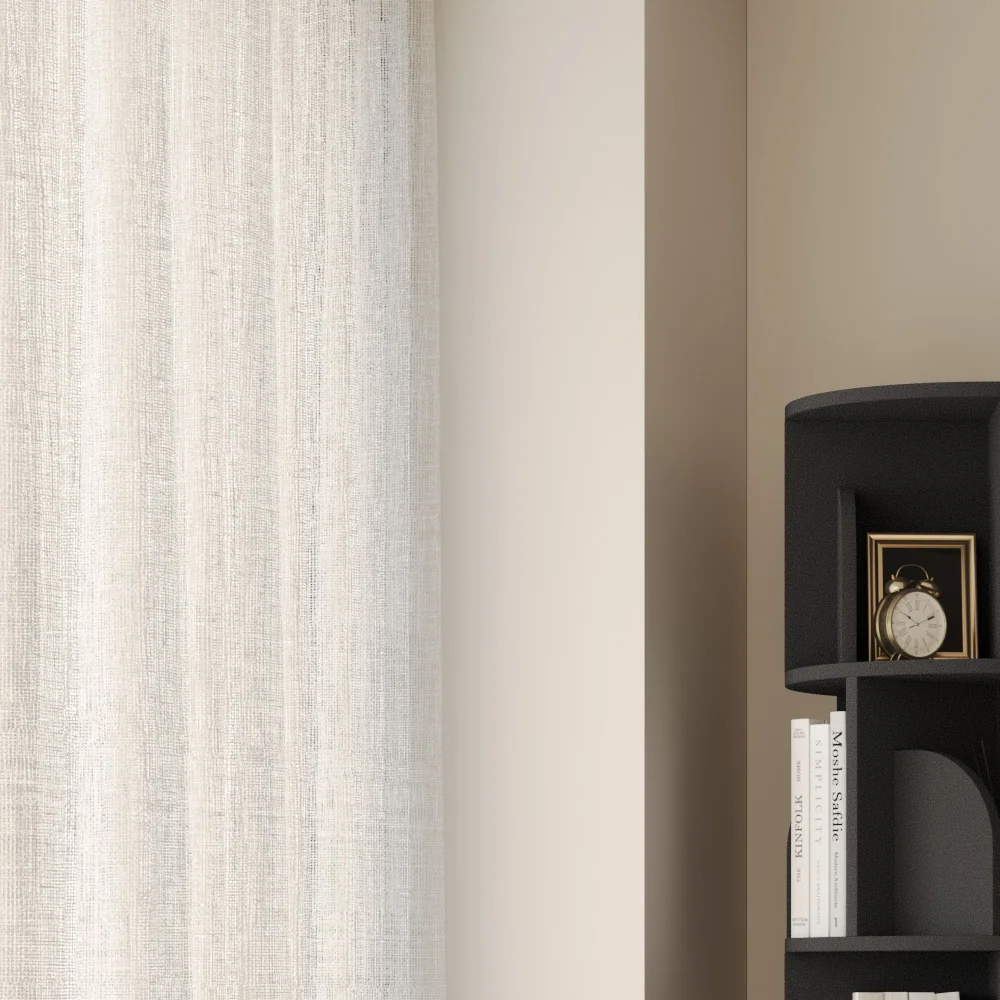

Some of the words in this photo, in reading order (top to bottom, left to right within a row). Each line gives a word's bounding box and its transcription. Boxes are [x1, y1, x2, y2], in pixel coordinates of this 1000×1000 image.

[832, 731, 843, 786] Moshe
[814, 739, 823, 845] SIMPLICITY
[832, 792, 843, 842] Safdie
[794, 794, 803, 858] KINFOLK
